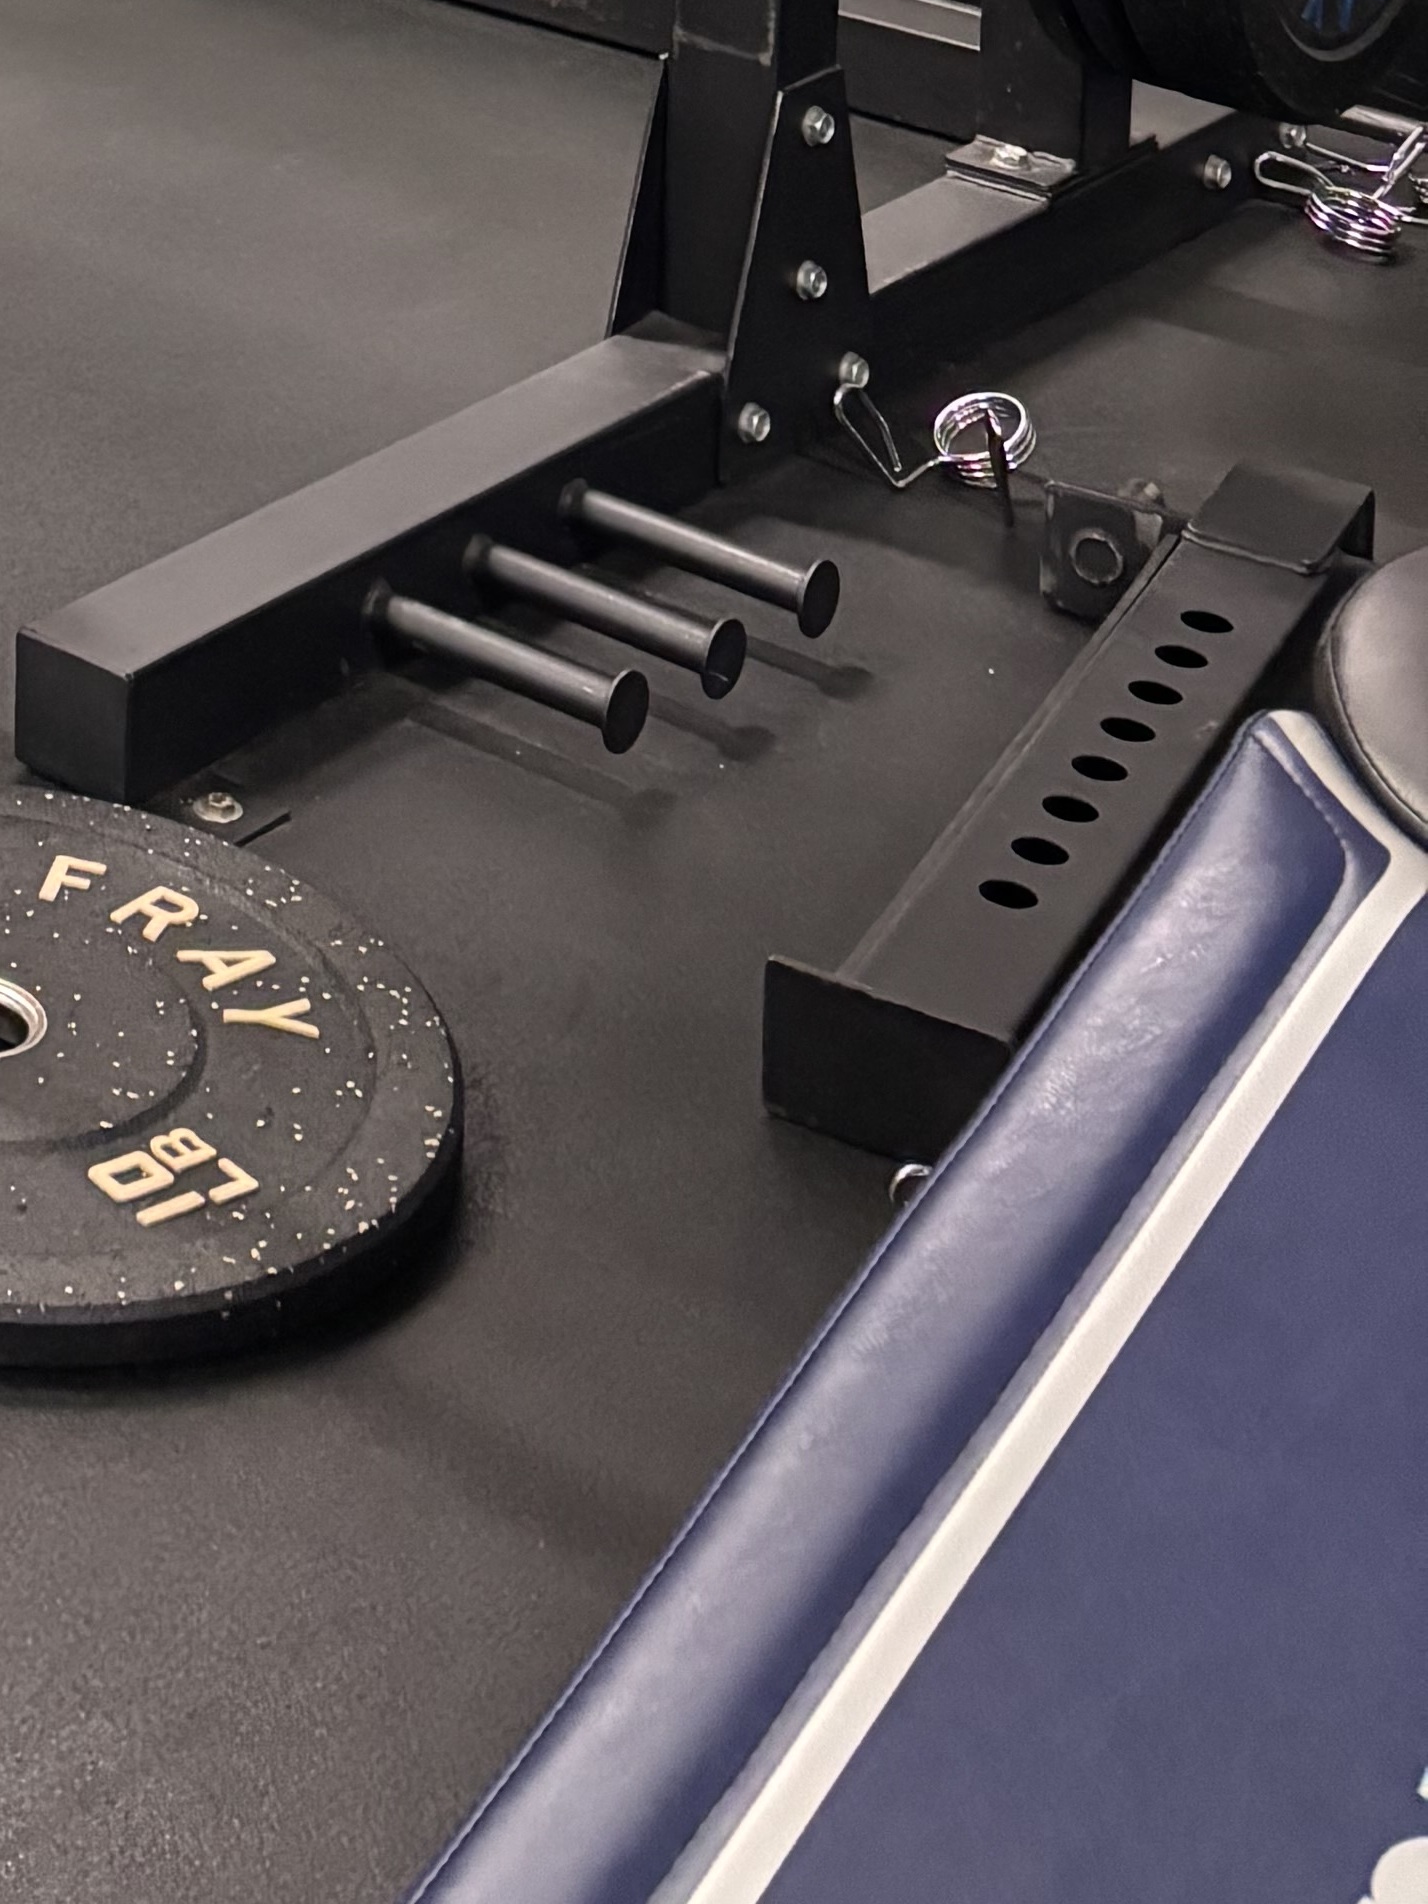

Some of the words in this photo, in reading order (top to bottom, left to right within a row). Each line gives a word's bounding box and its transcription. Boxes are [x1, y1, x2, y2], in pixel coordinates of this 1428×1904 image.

[38, 854, 320, 1040] FRAY
[87, 1149, 204, 1227] 10
[148, 1126, 259, 1204] LB
